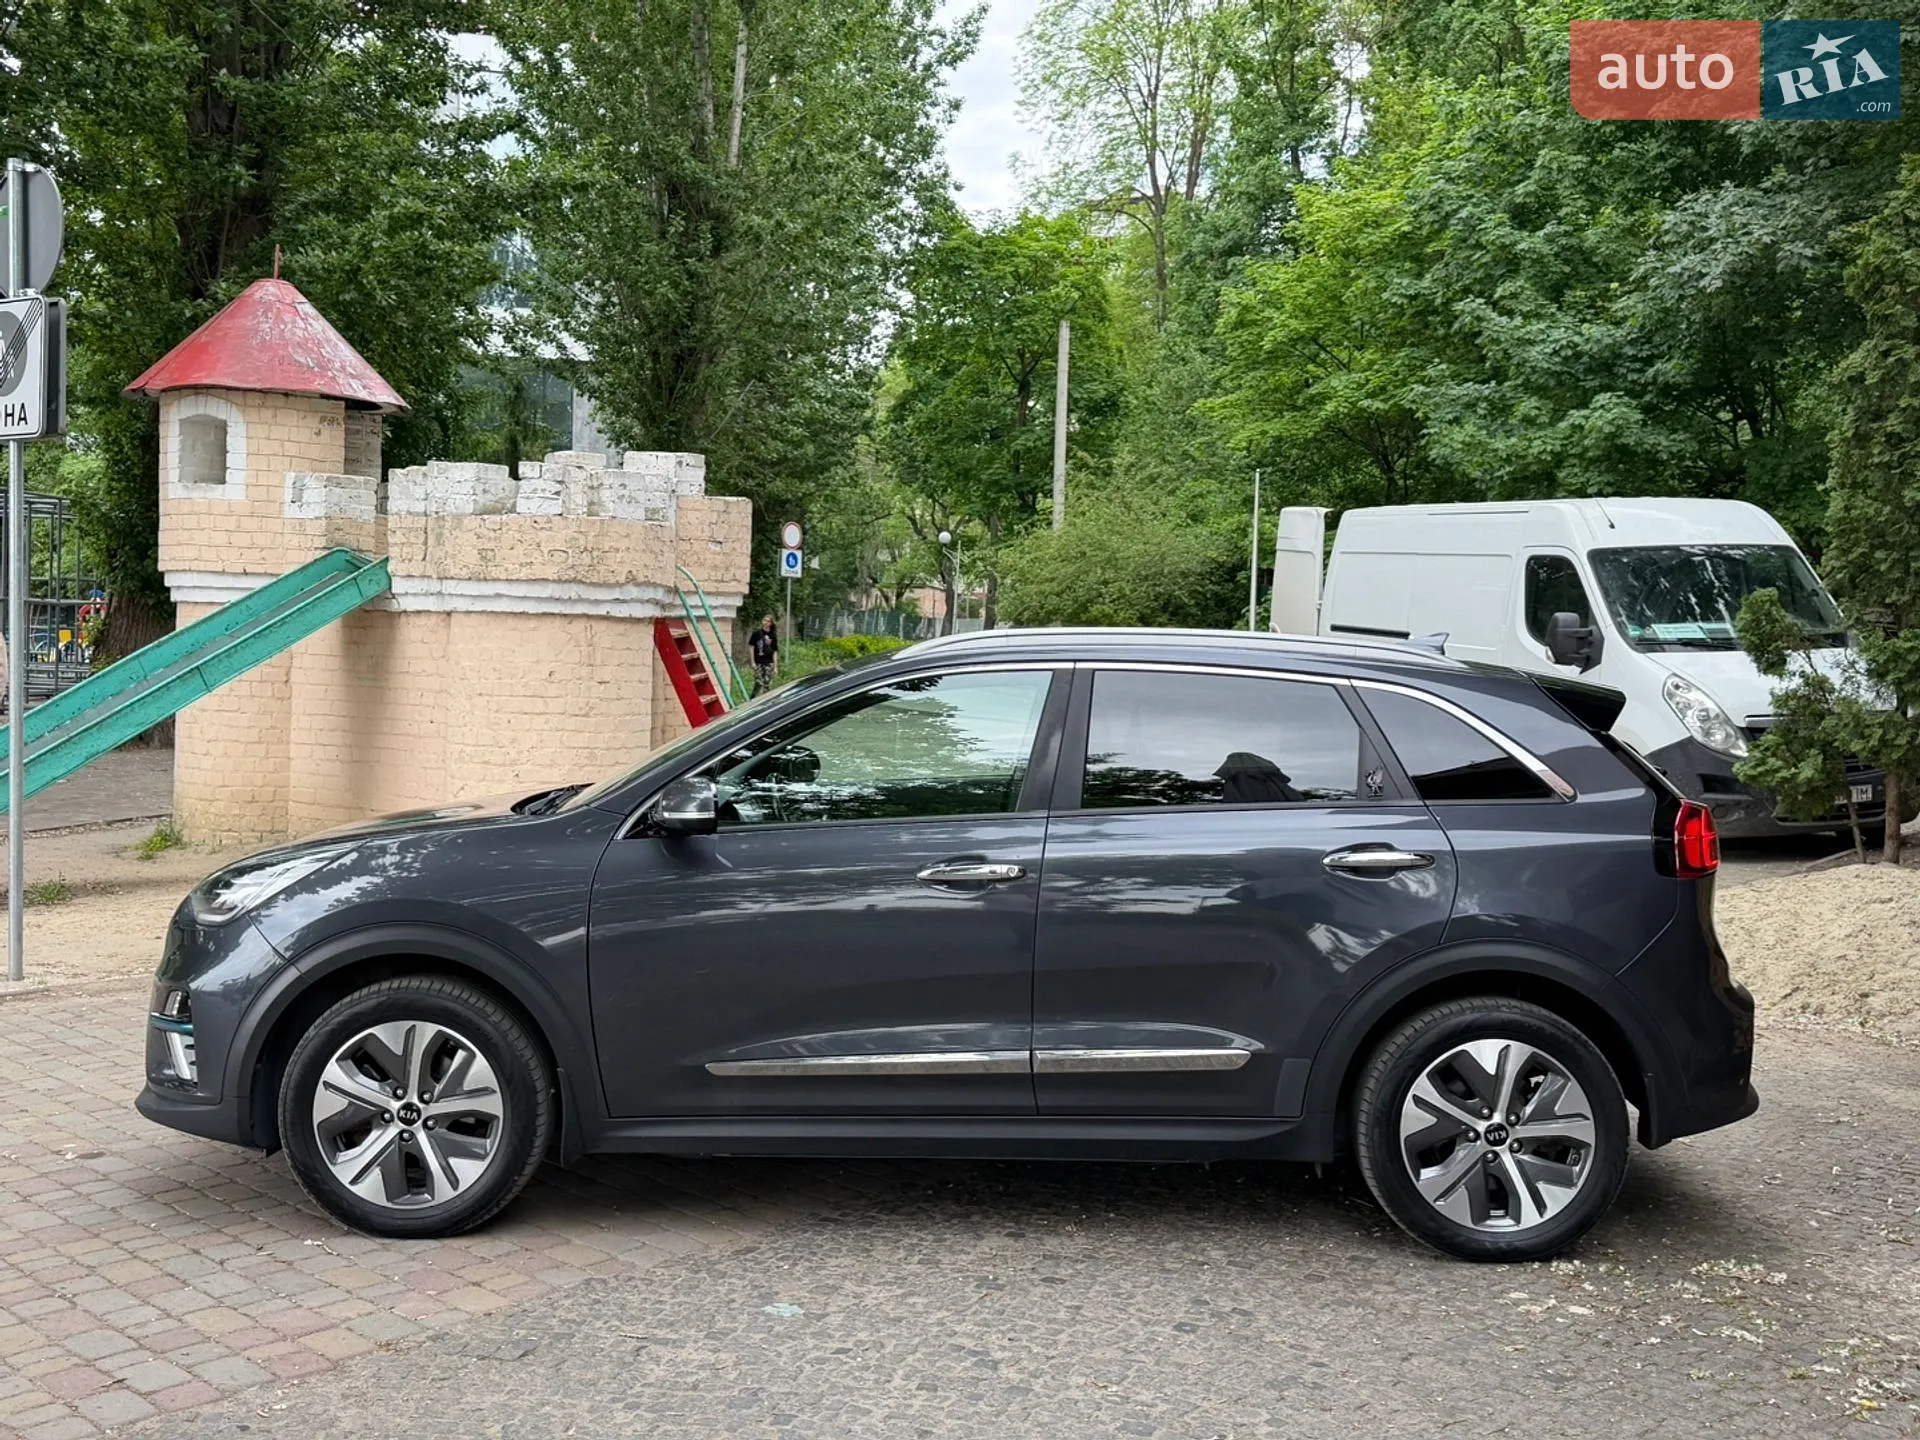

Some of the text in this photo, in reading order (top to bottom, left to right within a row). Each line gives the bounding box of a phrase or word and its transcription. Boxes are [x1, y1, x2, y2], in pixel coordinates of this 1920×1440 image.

[0, 402, 28, 427] НА
[399, 1109, 418, 1120] KIA
[1486, 1130, 1507, 1141] KIA
